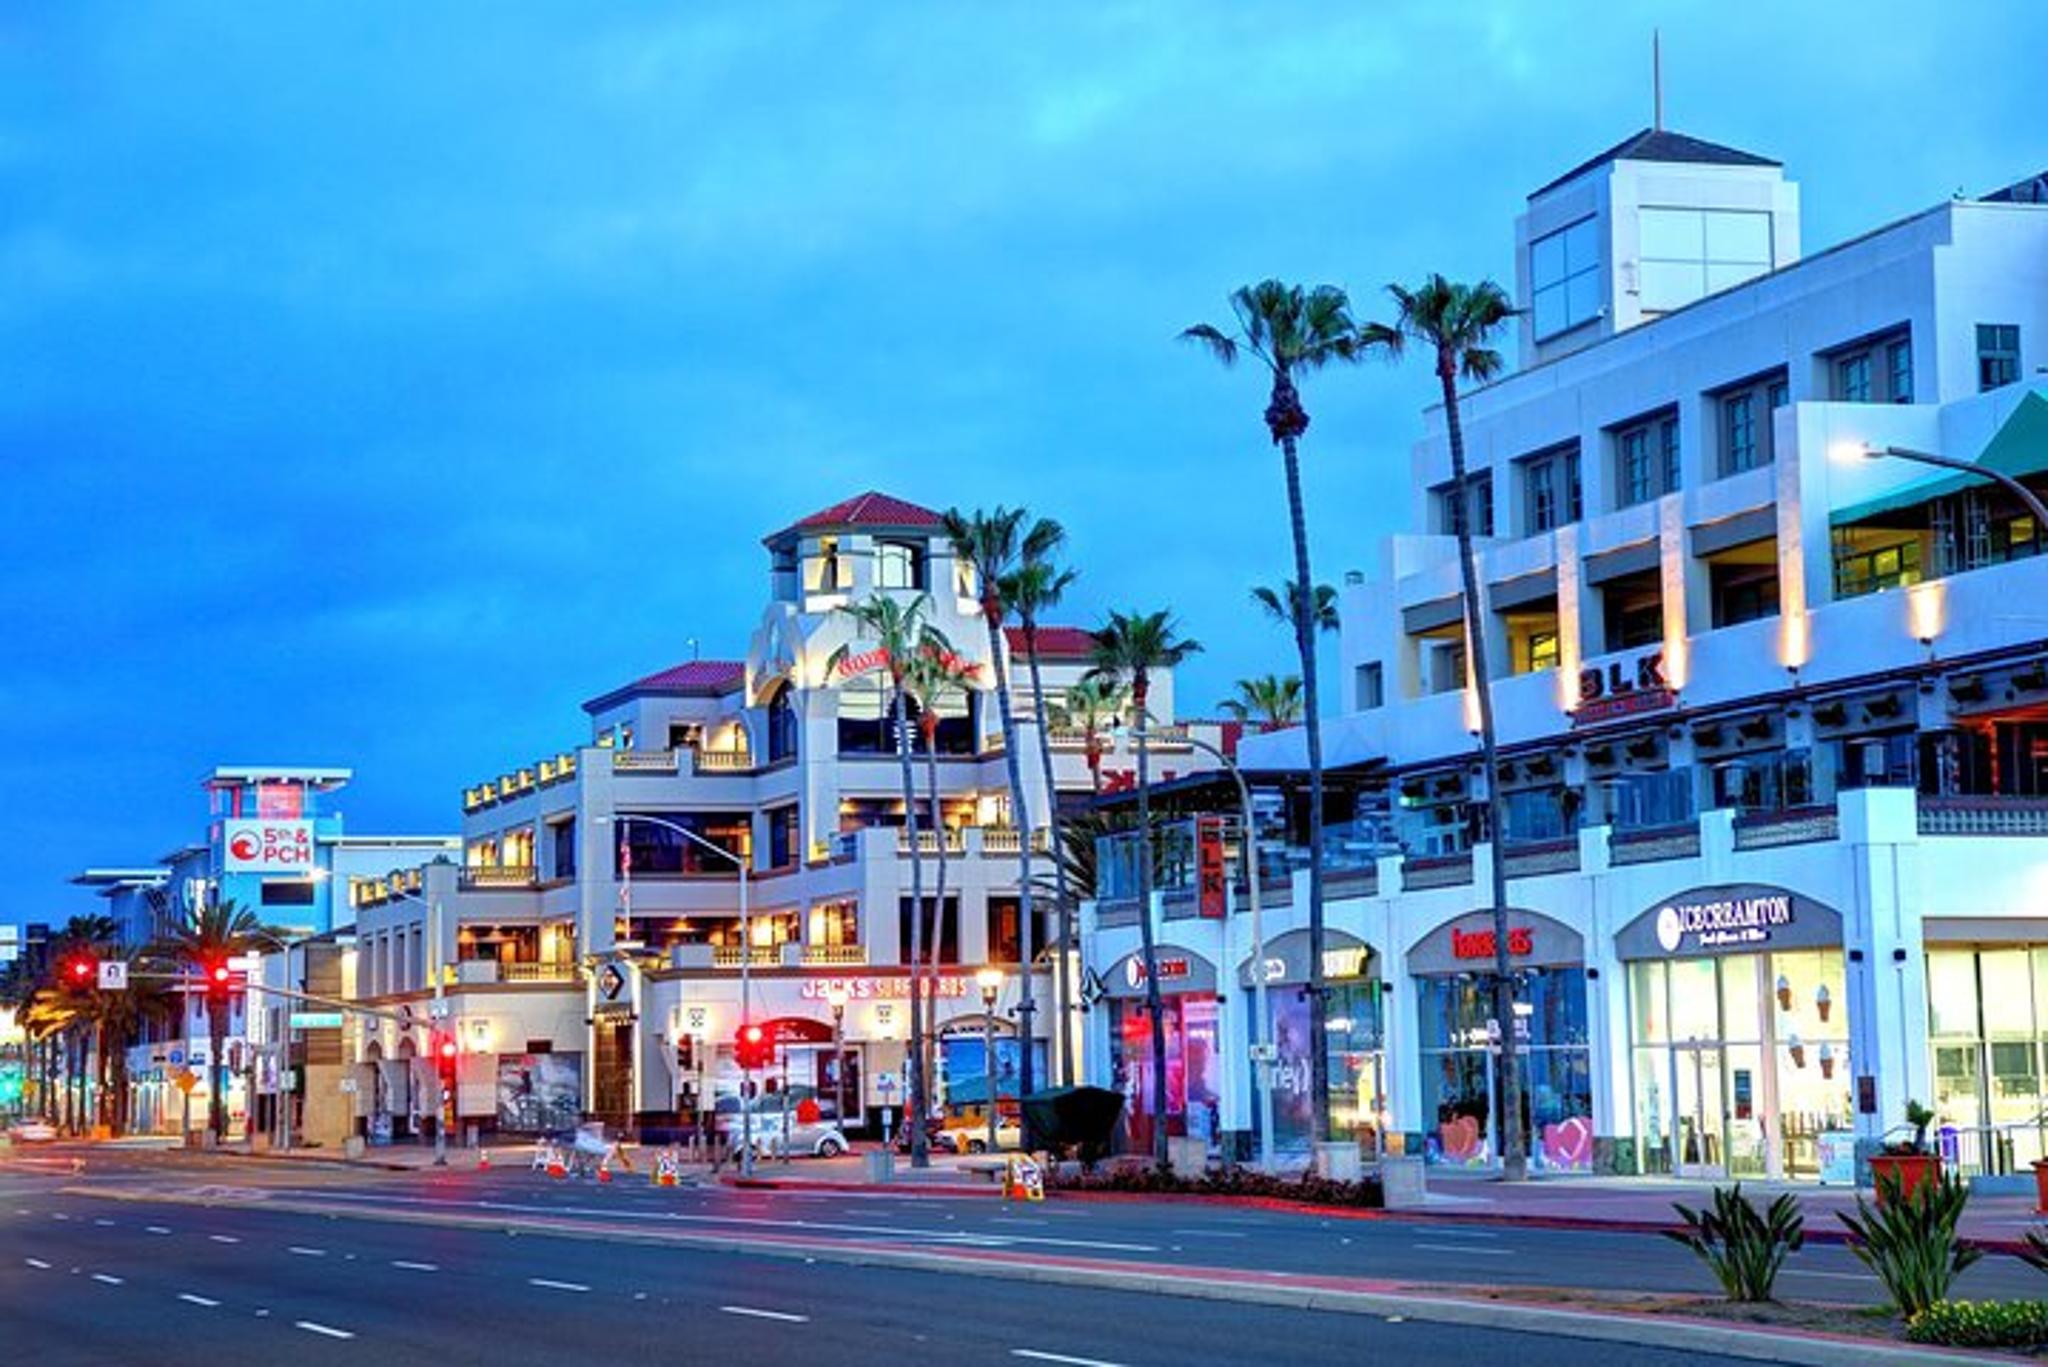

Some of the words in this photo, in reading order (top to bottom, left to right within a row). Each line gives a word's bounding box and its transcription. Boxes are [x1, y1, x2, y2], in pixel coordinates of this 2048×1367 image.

[1579, 651, 1666, 699] BLK
[295, 827, 308, 844] &
[264, 846, 310, 863] PCH
[873, 976, 968, 998] SURFORDS
